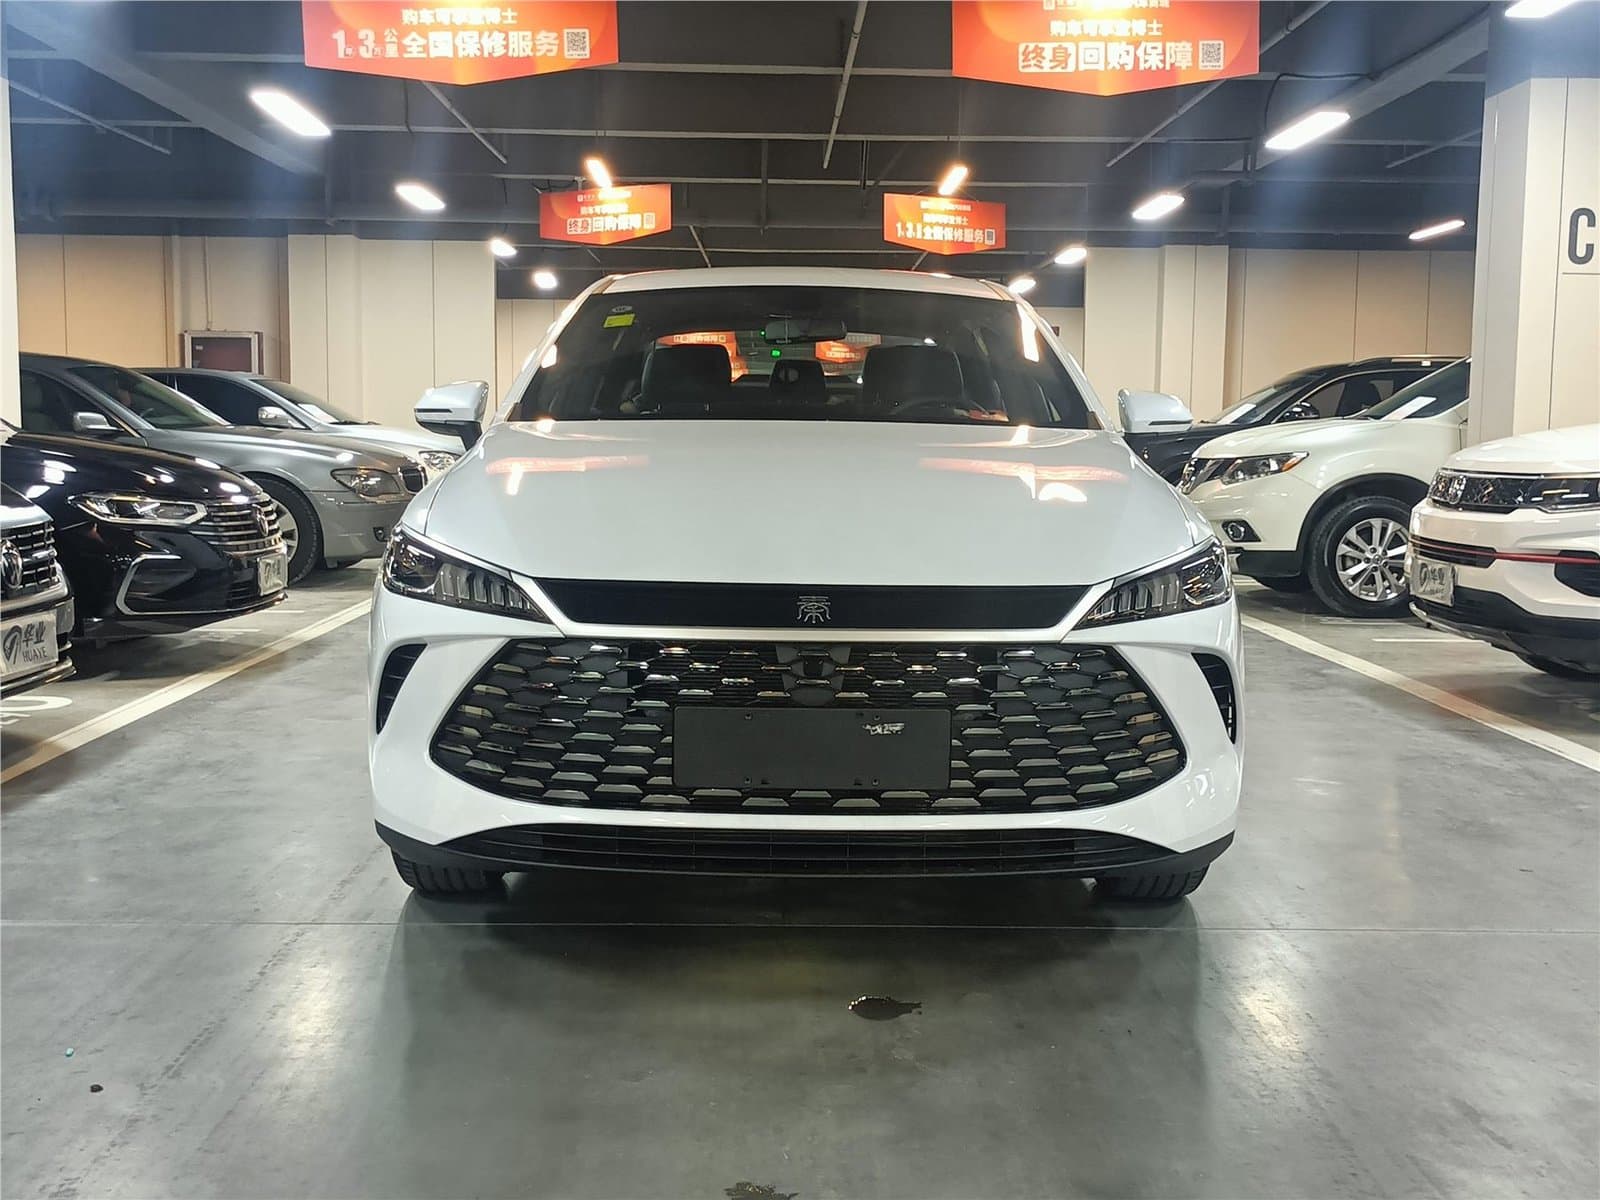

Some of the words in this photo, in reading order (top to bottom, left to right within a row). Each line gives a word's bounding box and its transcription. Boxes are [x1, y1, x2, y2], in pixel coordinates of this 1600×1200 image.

[1020, 41, 1193, 72] 终身回购保障
[1567, 207, 1596, 265] C
[22, 620, 46, 647] 华业
[22, 646, 48, 663] HUAYE
